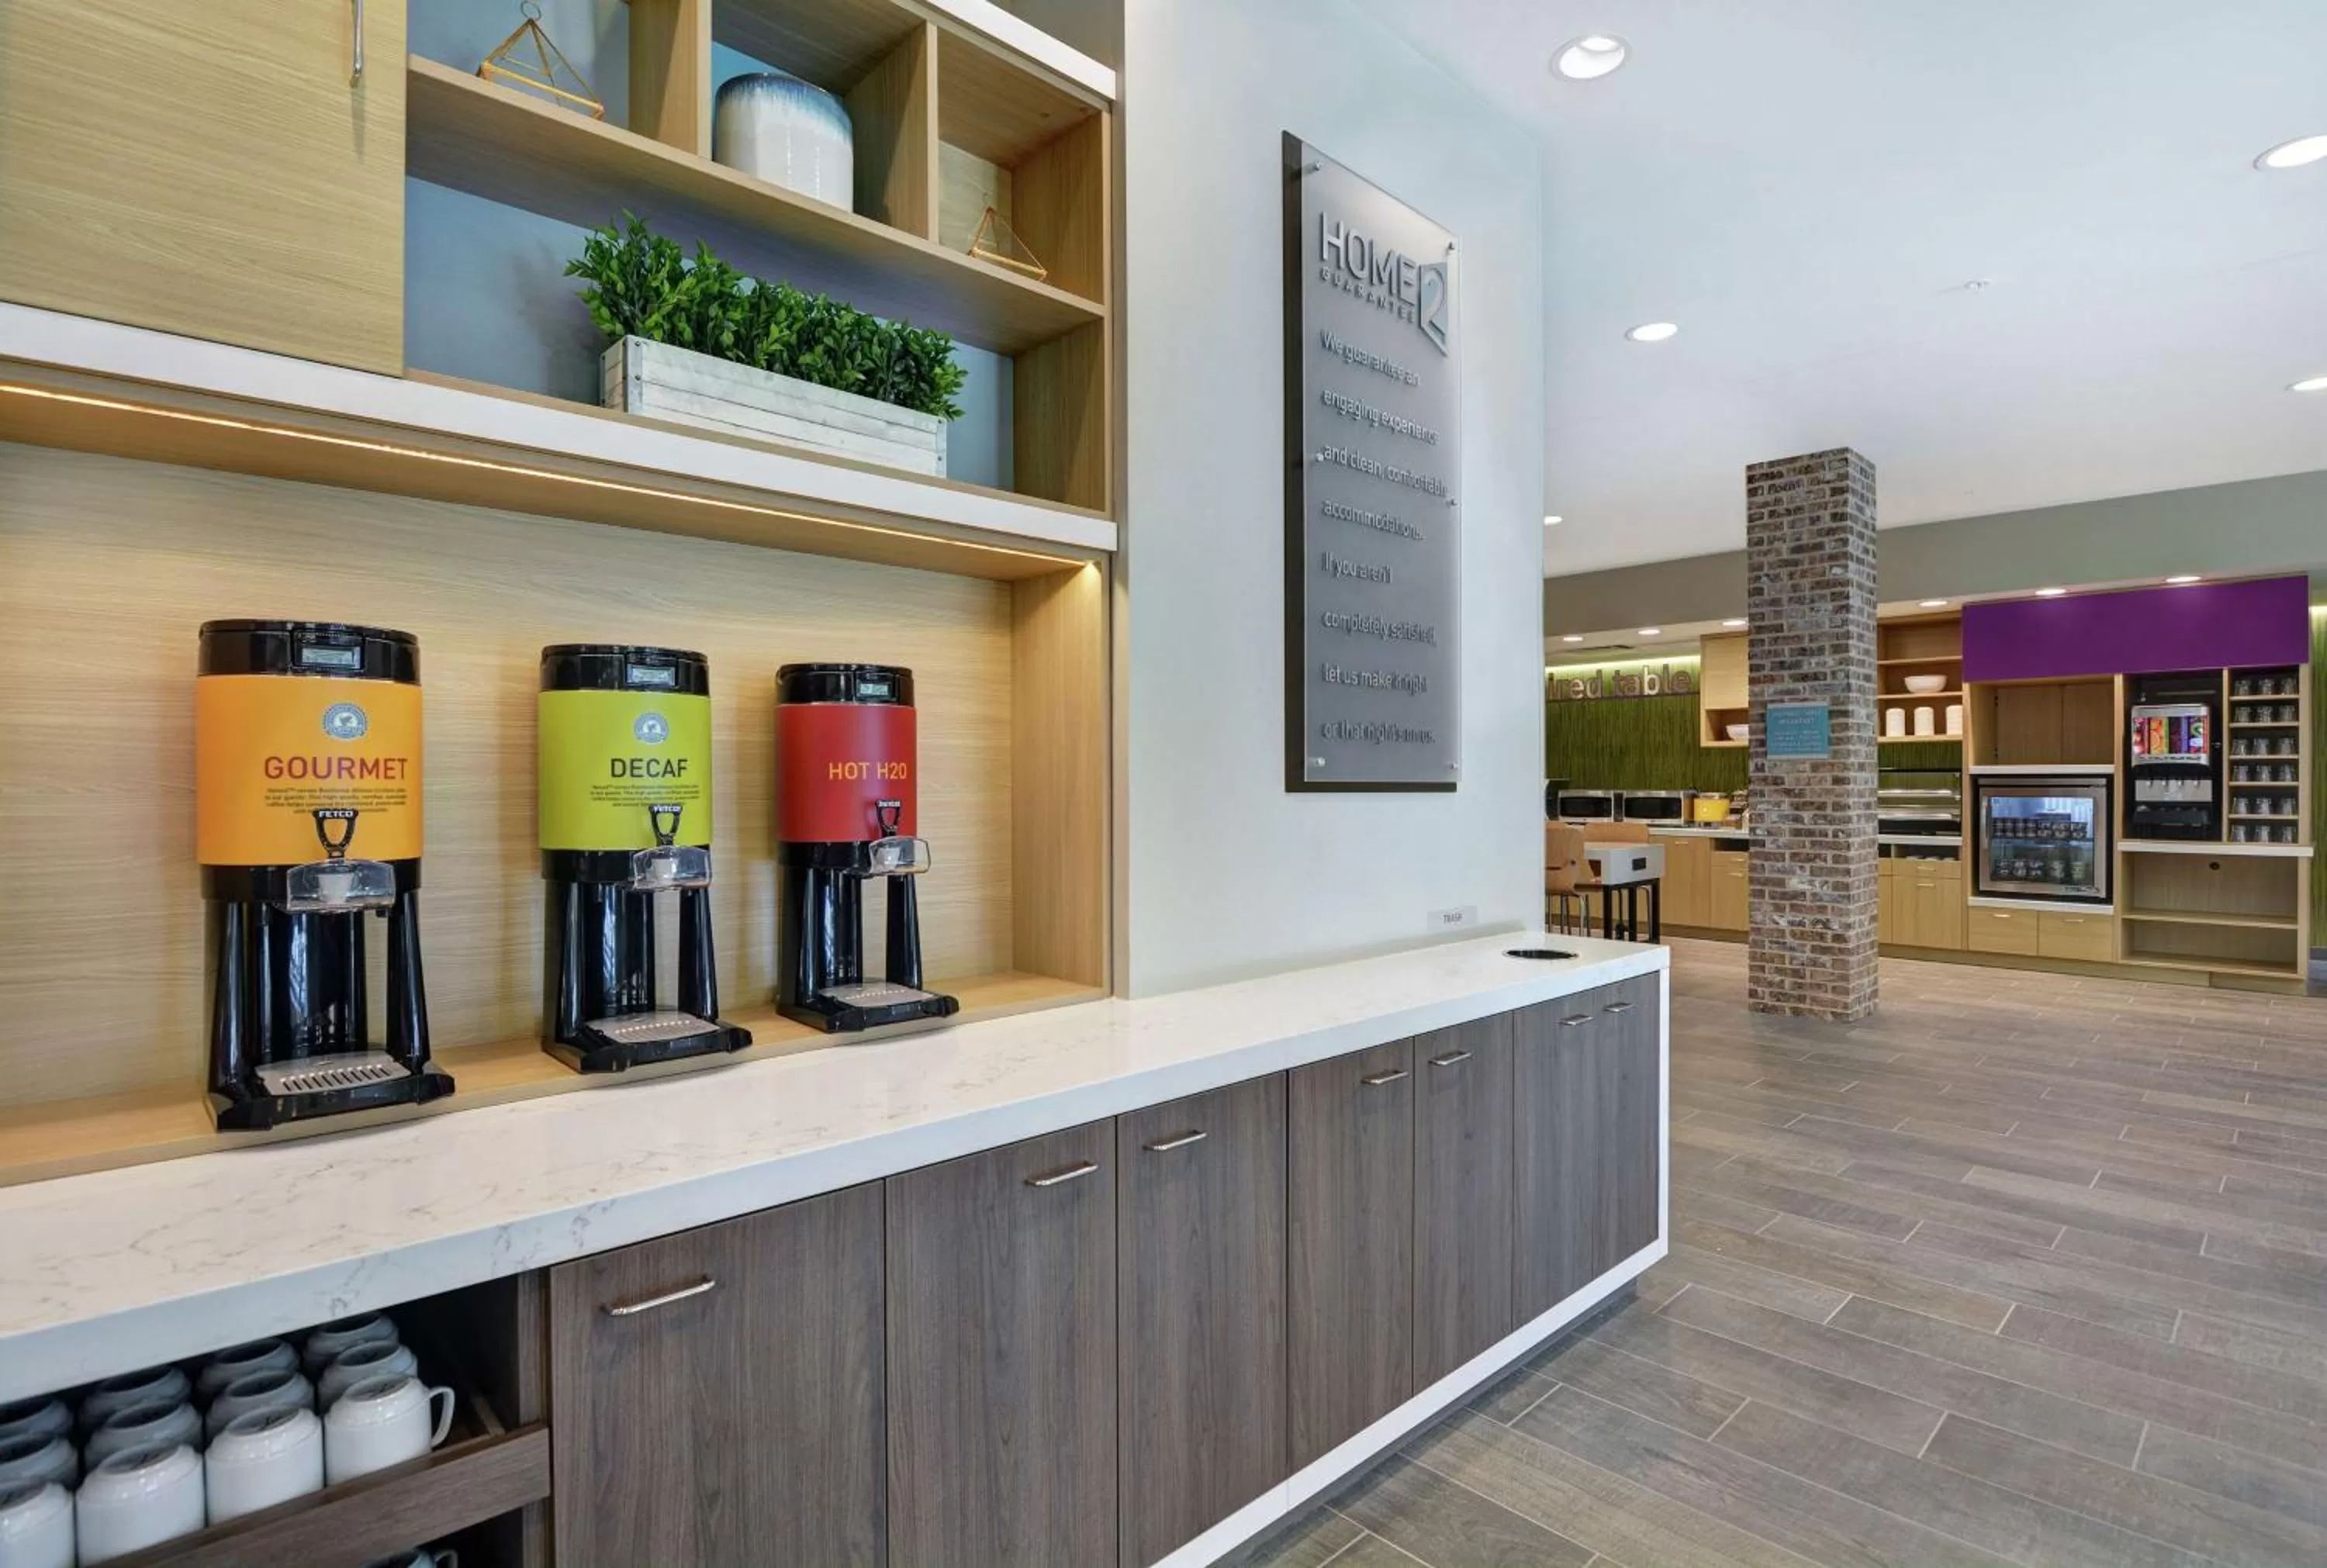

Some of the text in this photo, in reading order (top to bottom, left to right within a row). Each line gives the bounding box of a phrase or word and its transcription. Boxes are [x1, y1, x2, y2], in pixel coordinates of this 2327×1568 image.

[1321, 329, 1343, 354] We
[1405, 370, 1421, 385] an
[1322, 389, 1440, 445] engaging experience
[1323, 444, 1347, 465] and
[1321, 551, 1333, 572] If
[1334, 558, 1357, 579] you
[1322, 612, 1389, 641] completely
[1322, 663, 1340, 683] let
[1343, 669, 1358, 685] us
[1360, 669, 1392, 689] make
[1613, 663, 1691, 696] table
[1322, 722, 1337, 739] or
[265, 756, 408, 780] GOURMET
[610, 758, 689, 779] DECAF
[829, 762, 869, 780] HOT
[319, 810, 354, 818] FETCO
